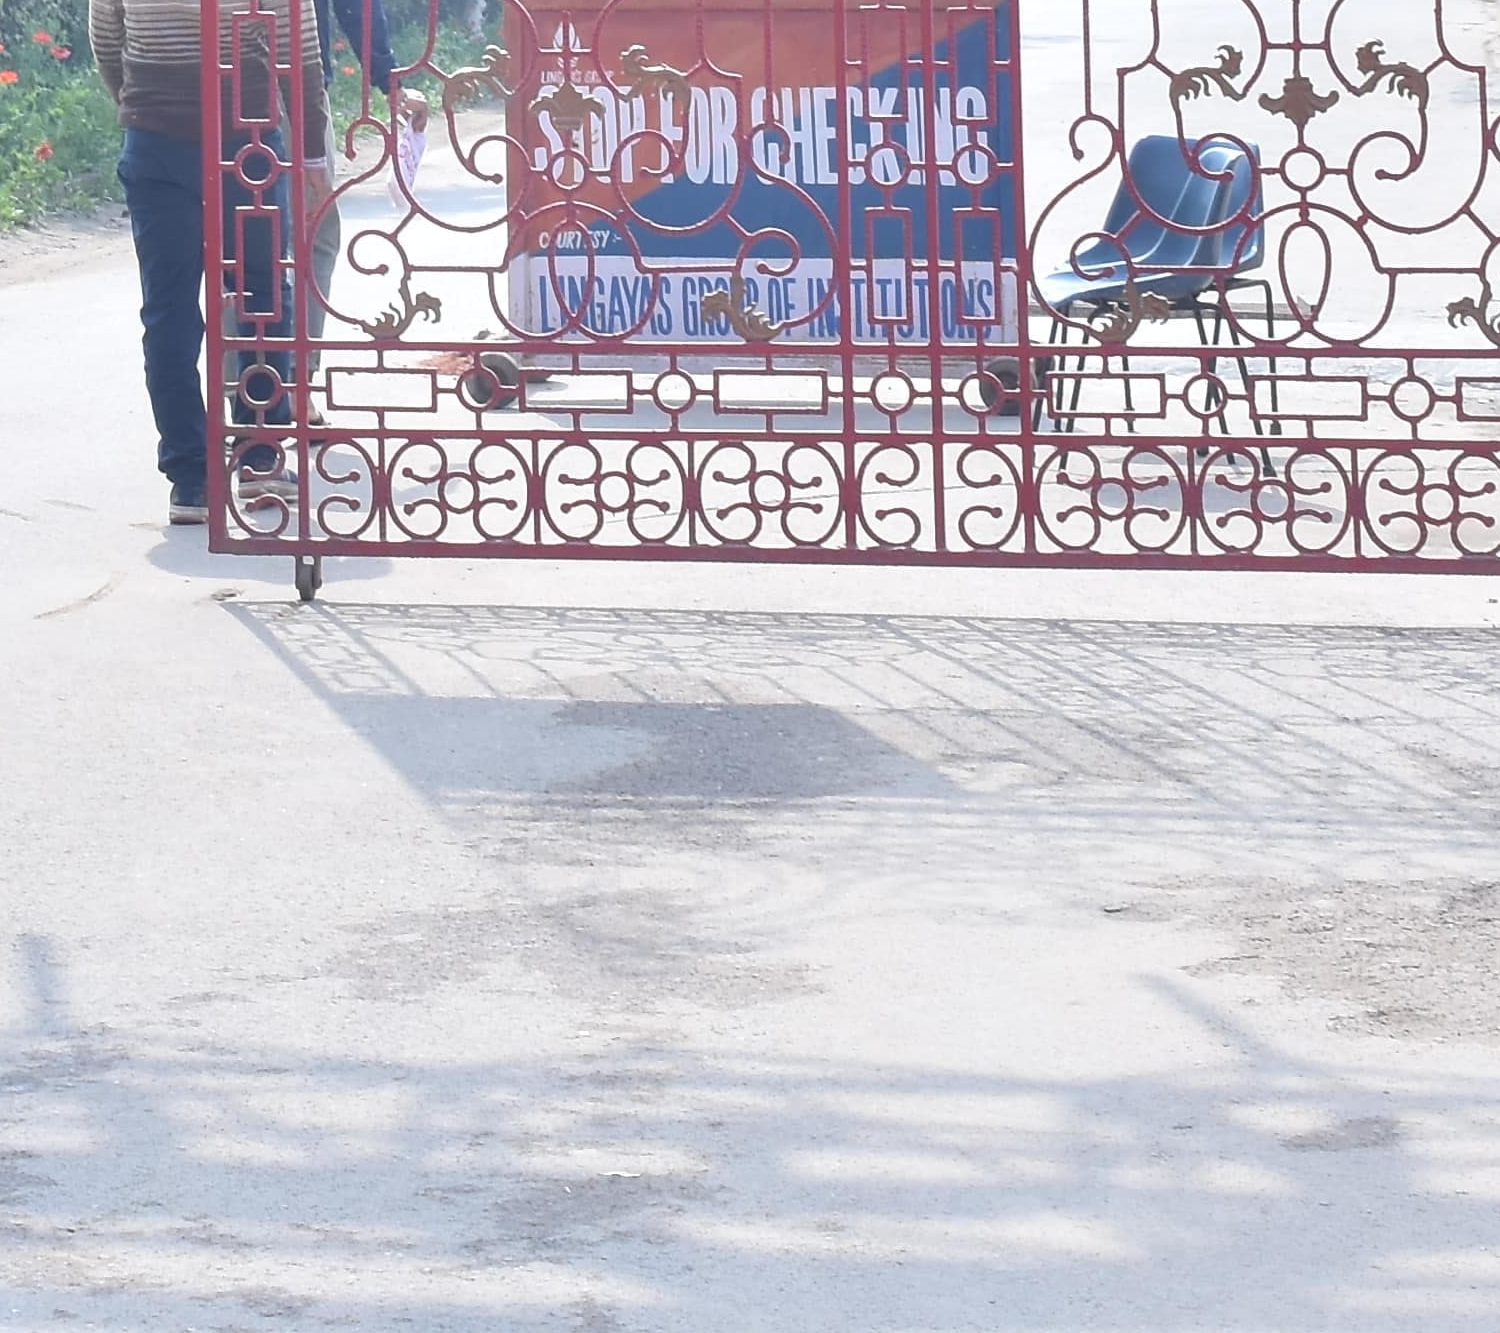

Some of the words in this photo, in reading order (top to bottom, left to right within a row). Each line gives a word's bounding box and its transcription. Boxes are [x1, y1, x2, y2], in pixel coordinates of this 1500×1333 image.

[659, 85, 739, 185] FOR
[751, 85, 990, 187] CHECKING
[768, 277, 796, 337] OF
